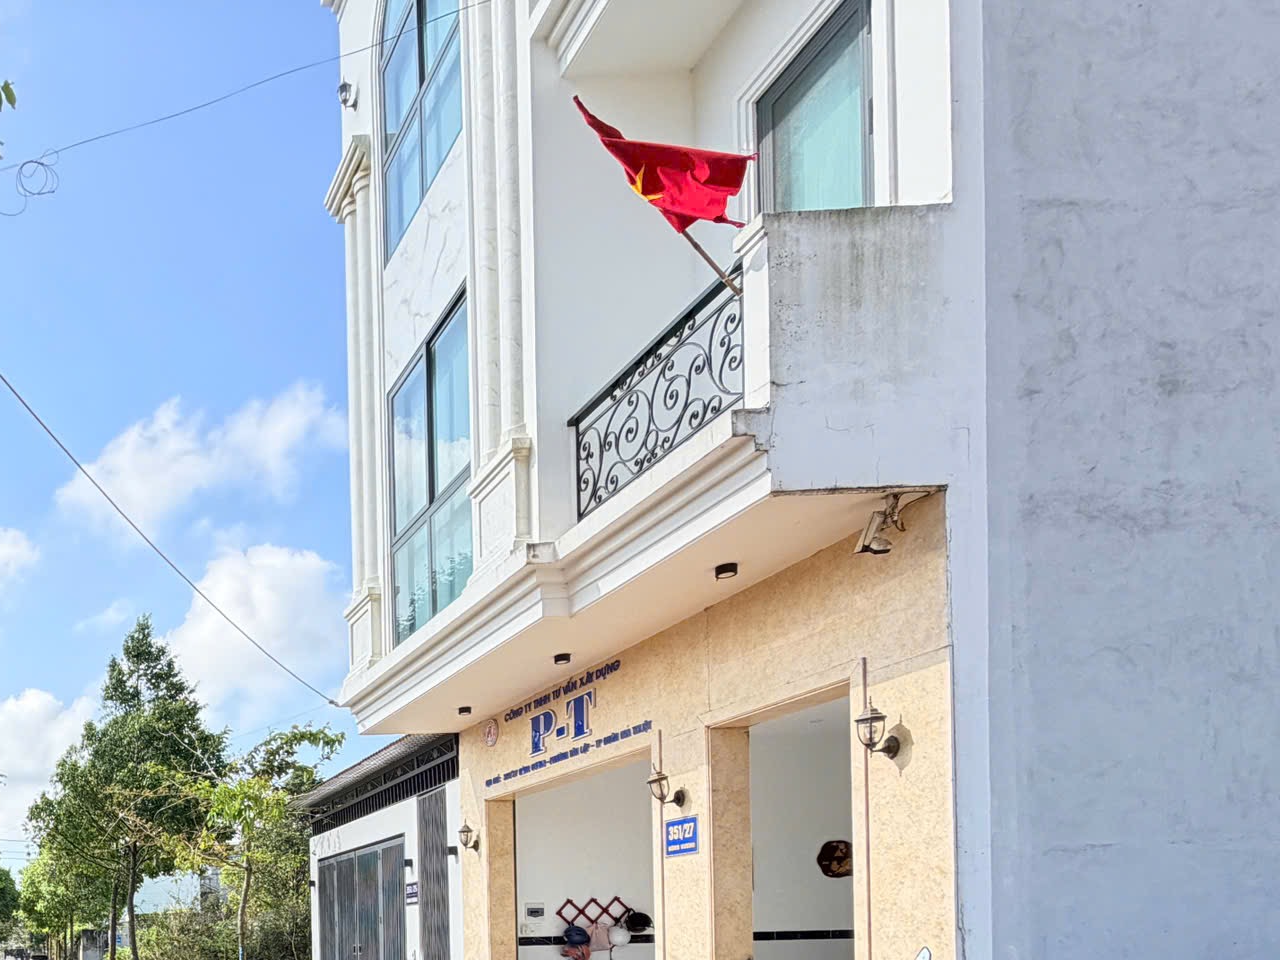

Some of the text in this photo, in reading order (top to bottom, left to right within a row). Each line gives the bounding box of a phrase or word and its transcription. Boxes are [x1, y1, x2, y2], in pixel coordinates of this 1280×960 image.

[504, 706, 523, 722] CÔNG
[524, 701, 533, 714] TY
[552, 686, 562, 700] TƯ
[562, 677, 577, 695] VẤN
[579, 671, 594, 688] XÂY
[595, 659, 621, 680] DỰNG
[668, 822, 695, 841] 351/27
